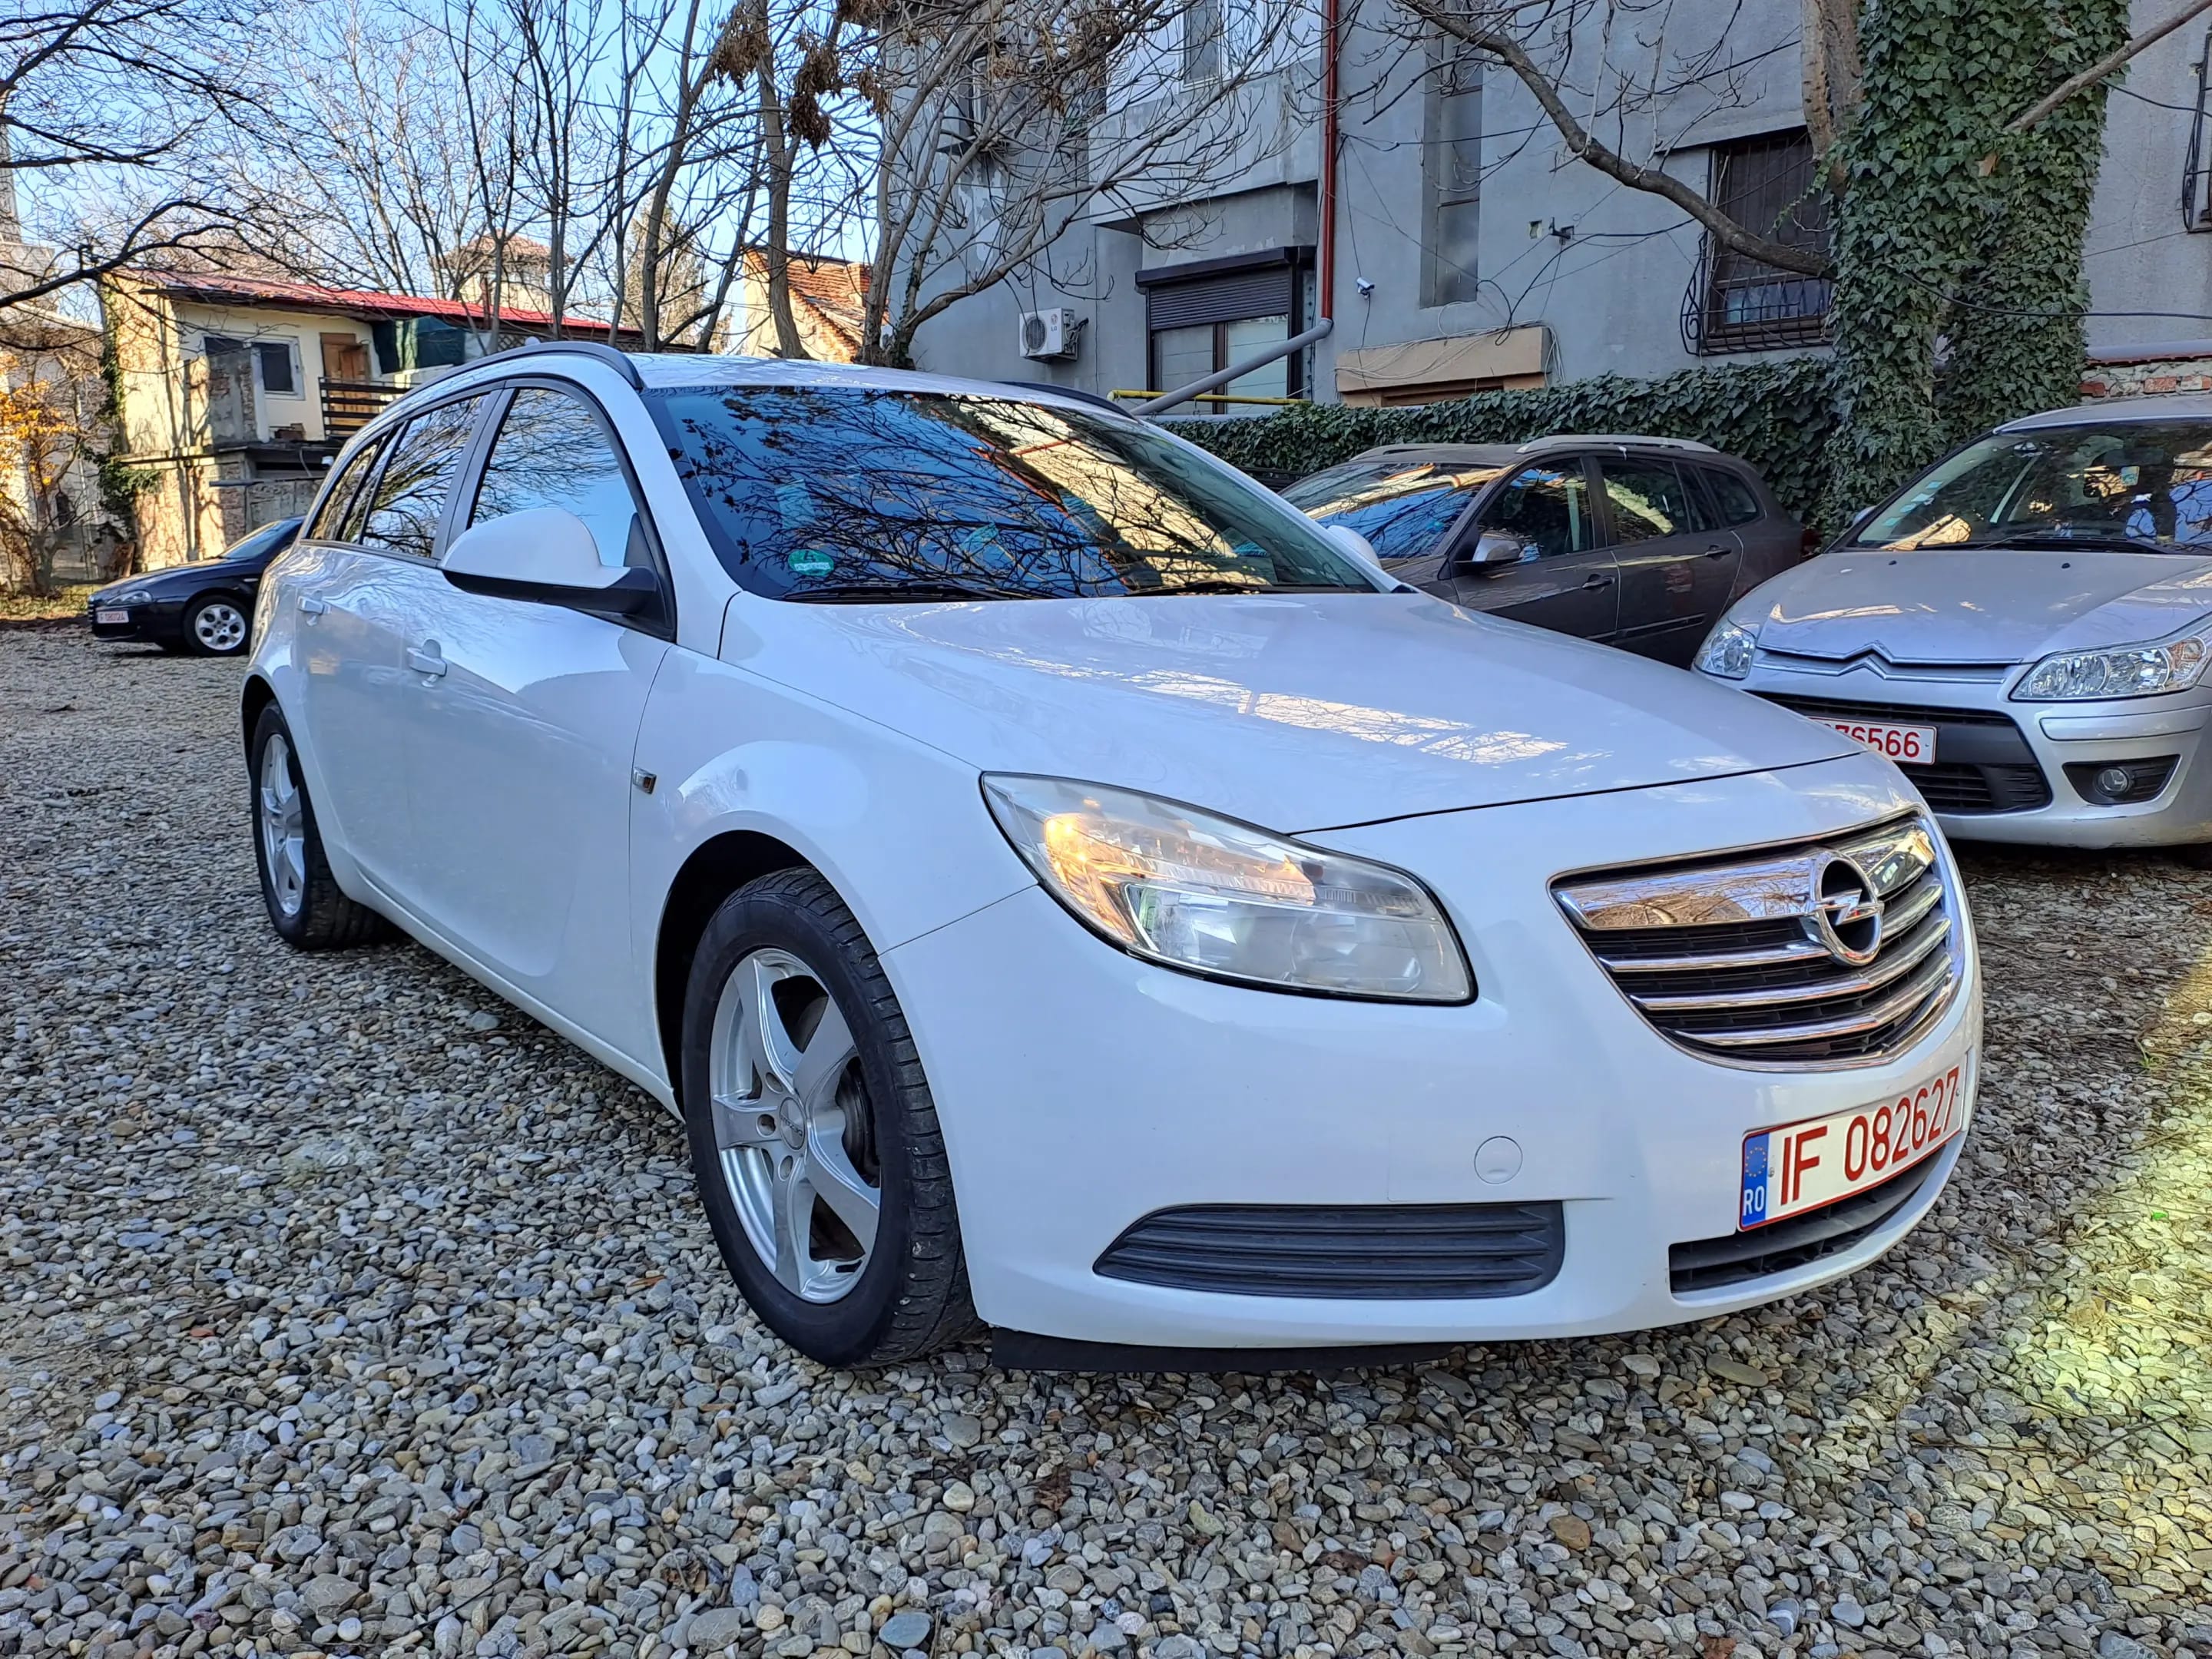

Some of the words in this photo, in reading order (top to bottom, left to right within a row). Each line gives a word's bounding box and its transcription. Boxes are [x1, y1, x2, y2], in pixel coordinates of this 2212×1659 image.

[1824, 724, 1920, 757] 76566
[1780, 1124, 1828, 1206] IF
[1844, 1065, 1960, 1181] 082627
[1743, 1185, 1765, 1216] RO
